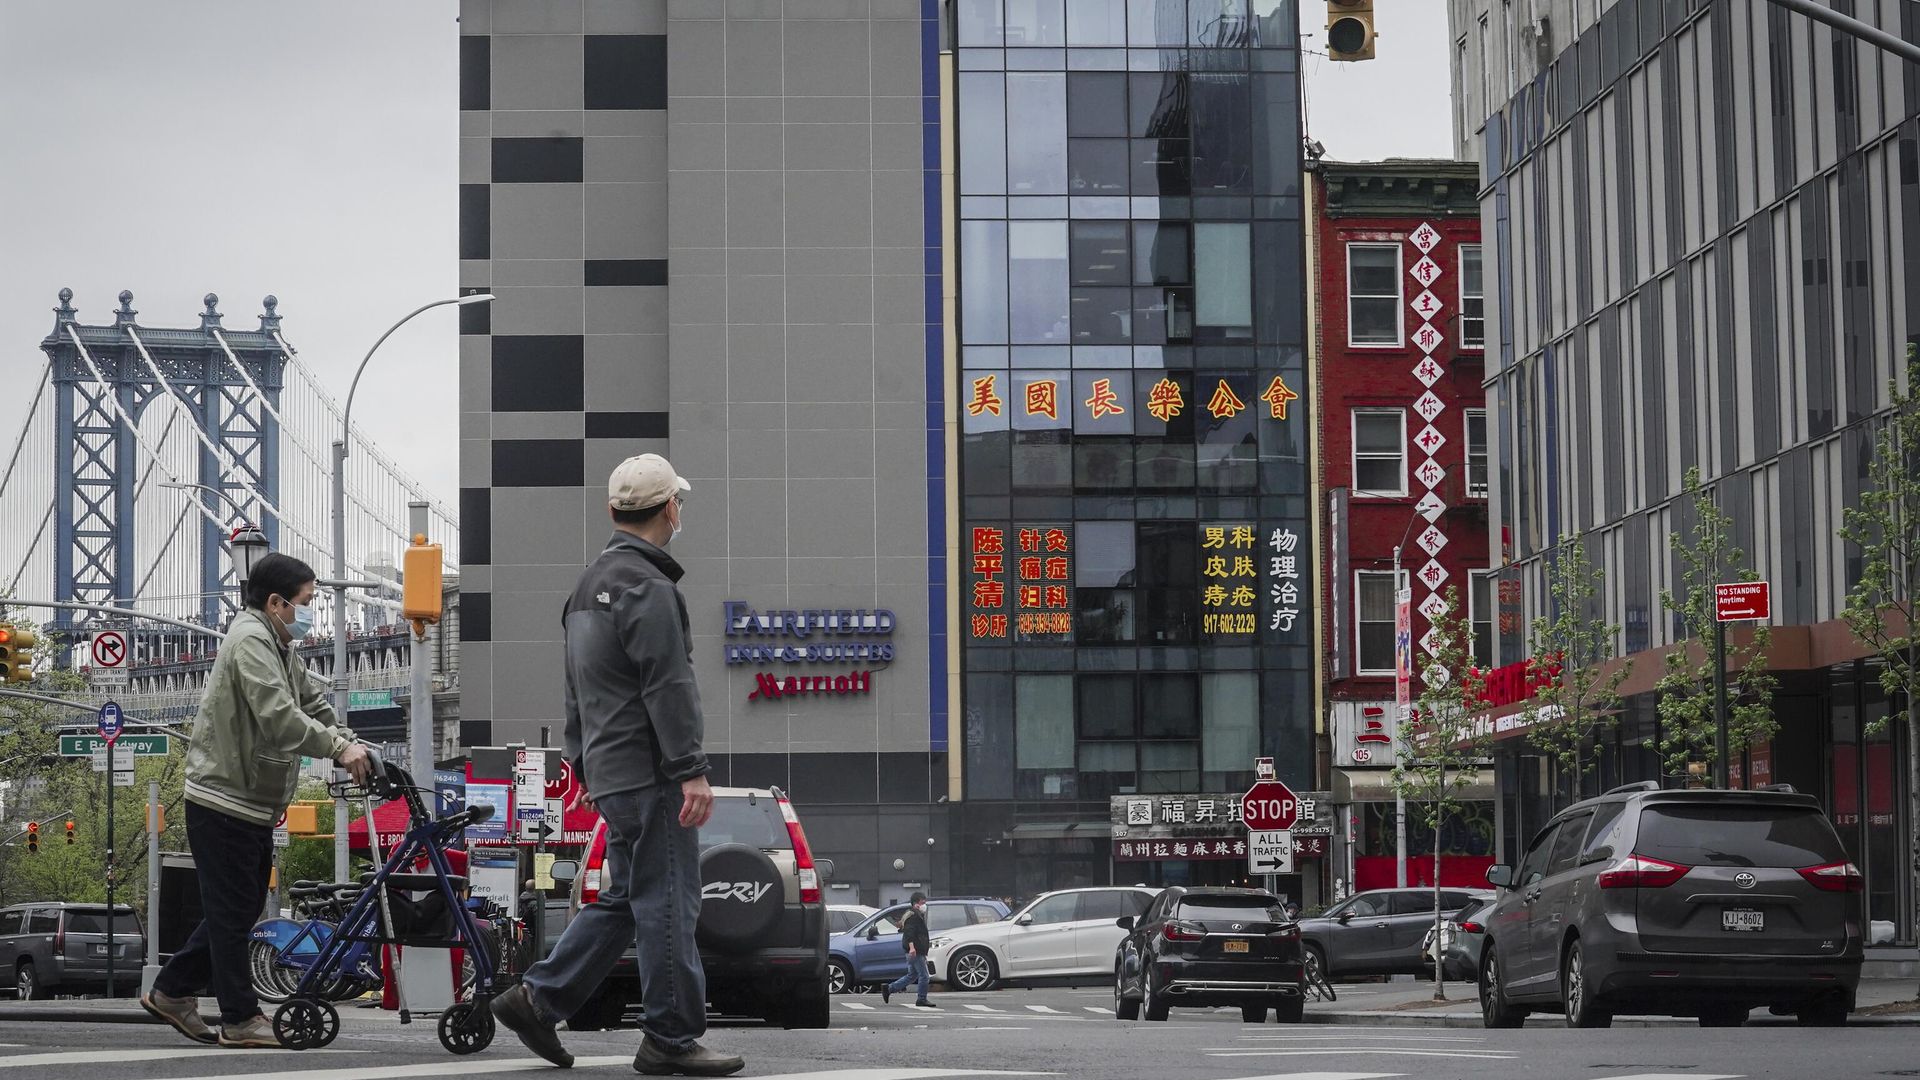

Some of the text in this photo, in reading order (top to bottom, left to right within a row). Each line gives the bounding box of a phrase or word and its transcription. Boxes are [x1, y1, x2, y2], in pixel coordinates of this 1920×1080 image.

[967, 374, 1298, 422] 美國長樂公會
[1019, 528, 1067, 552] 针灸
[1202, 526, 1256, 549] 男科
[1019, 557, 1067, 580] 痛症
[1203, 555, 1257, 578] 皮肤
[1269, 527, 1299, 632] 物理治疗
[1718, 586, 1761, 596] NO STANDING
[1019, 585, 1067, 608] 妇科
[1203, 584, 1256, 607] 痔疮
[1719, 596, 1745, 605] Anytime
[723, 600, 897, 637] FAIRFIELD
[972, 614, 1007, 637] 诊所
[1203, 613, 1256, 634] 917-602-2229
[724, 641, 895, 664] INN & SUITES
[357, 692, 388, 701] BROADWAY
[748, 670, 870, 700] Marriott
[75, 740, 83, 751] E
[1355, 749, 1369, 760] 105
[1245, 799, 1294, 820] STOP
[1258, 834, 1283, 844] ALL
[1253, 847, 1289, 856] TRAFFIC
